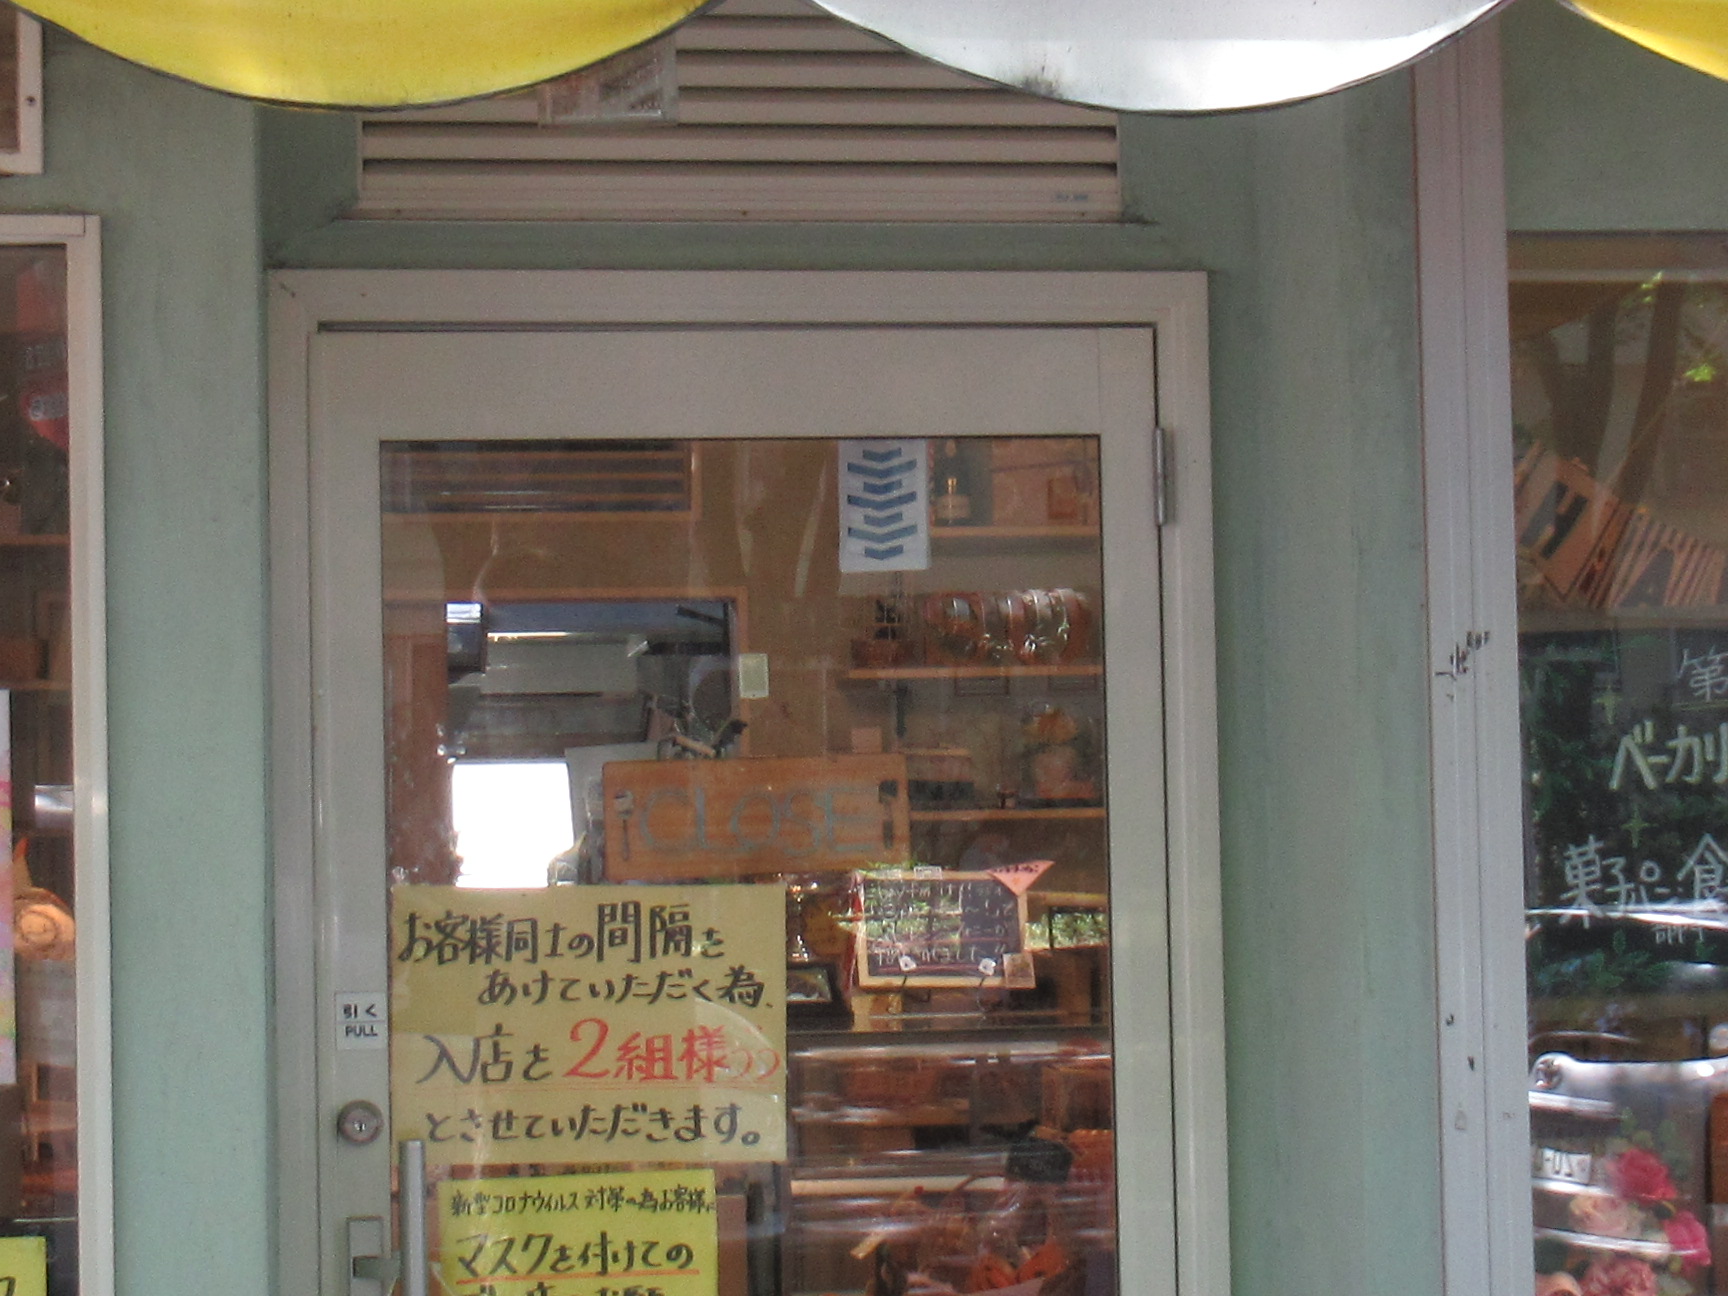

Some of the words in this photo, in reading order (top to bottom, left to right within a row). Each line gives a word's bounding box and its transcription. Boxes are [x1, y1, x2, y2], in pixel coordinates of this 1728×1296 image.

[638, 783, 875, 858] CLOSE
[397, 900, 726, 966] お客様同士の間隔を
[343, 1003, 378, 1020] 引く
[344, 1024, 378, 1039] PULL
[425, 1103, 762, 1147] とさせていただきます。
[456, 1230, 695, 1278] マスクを付けての
